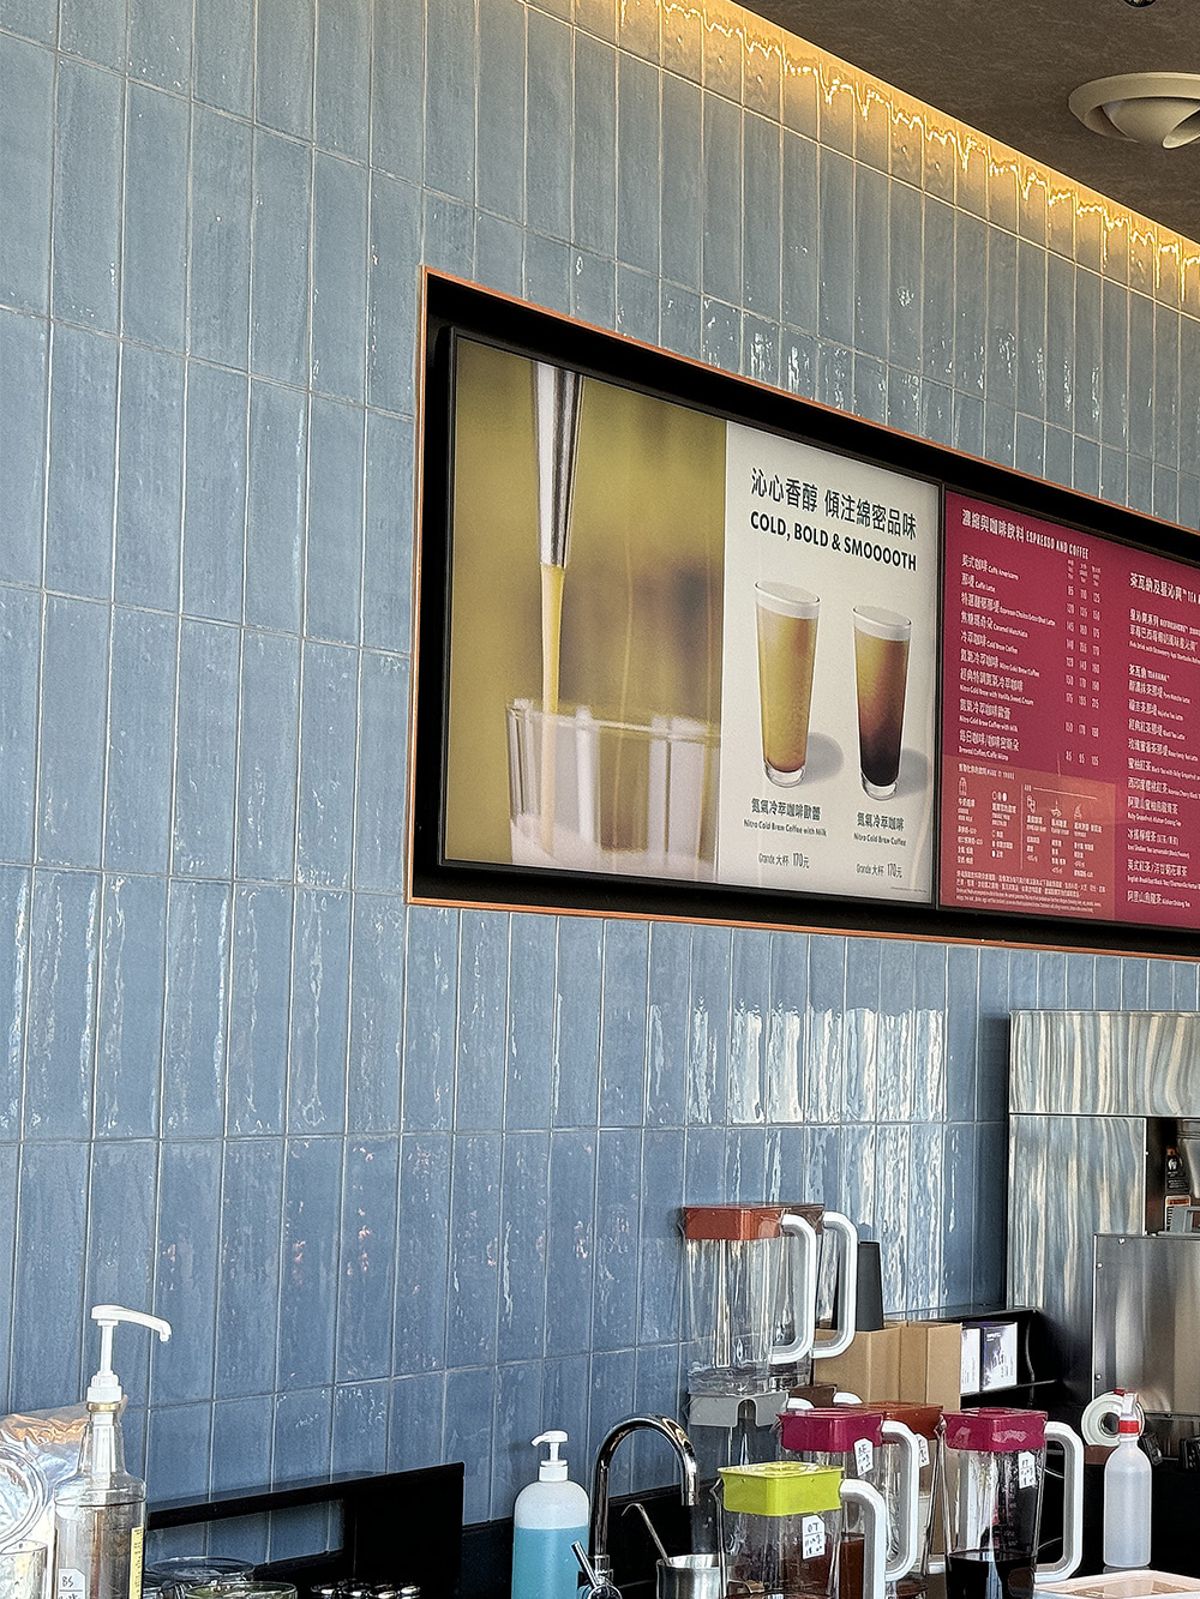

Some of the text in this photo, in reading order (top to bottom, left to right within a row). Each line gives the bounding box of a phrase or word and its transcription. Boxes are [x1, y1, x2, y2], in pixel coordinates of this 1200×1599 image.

[751, 467, 917, 540] 沁心香醇 傾注綿密品味
[750, 511, 917, 571] COLD, BOLD & SMOOOOTH
[1056, 539, 1067, 553] AND
[1069, 543, 1088, 559] COFFEE
[758, 821, 770, 830] Cold
